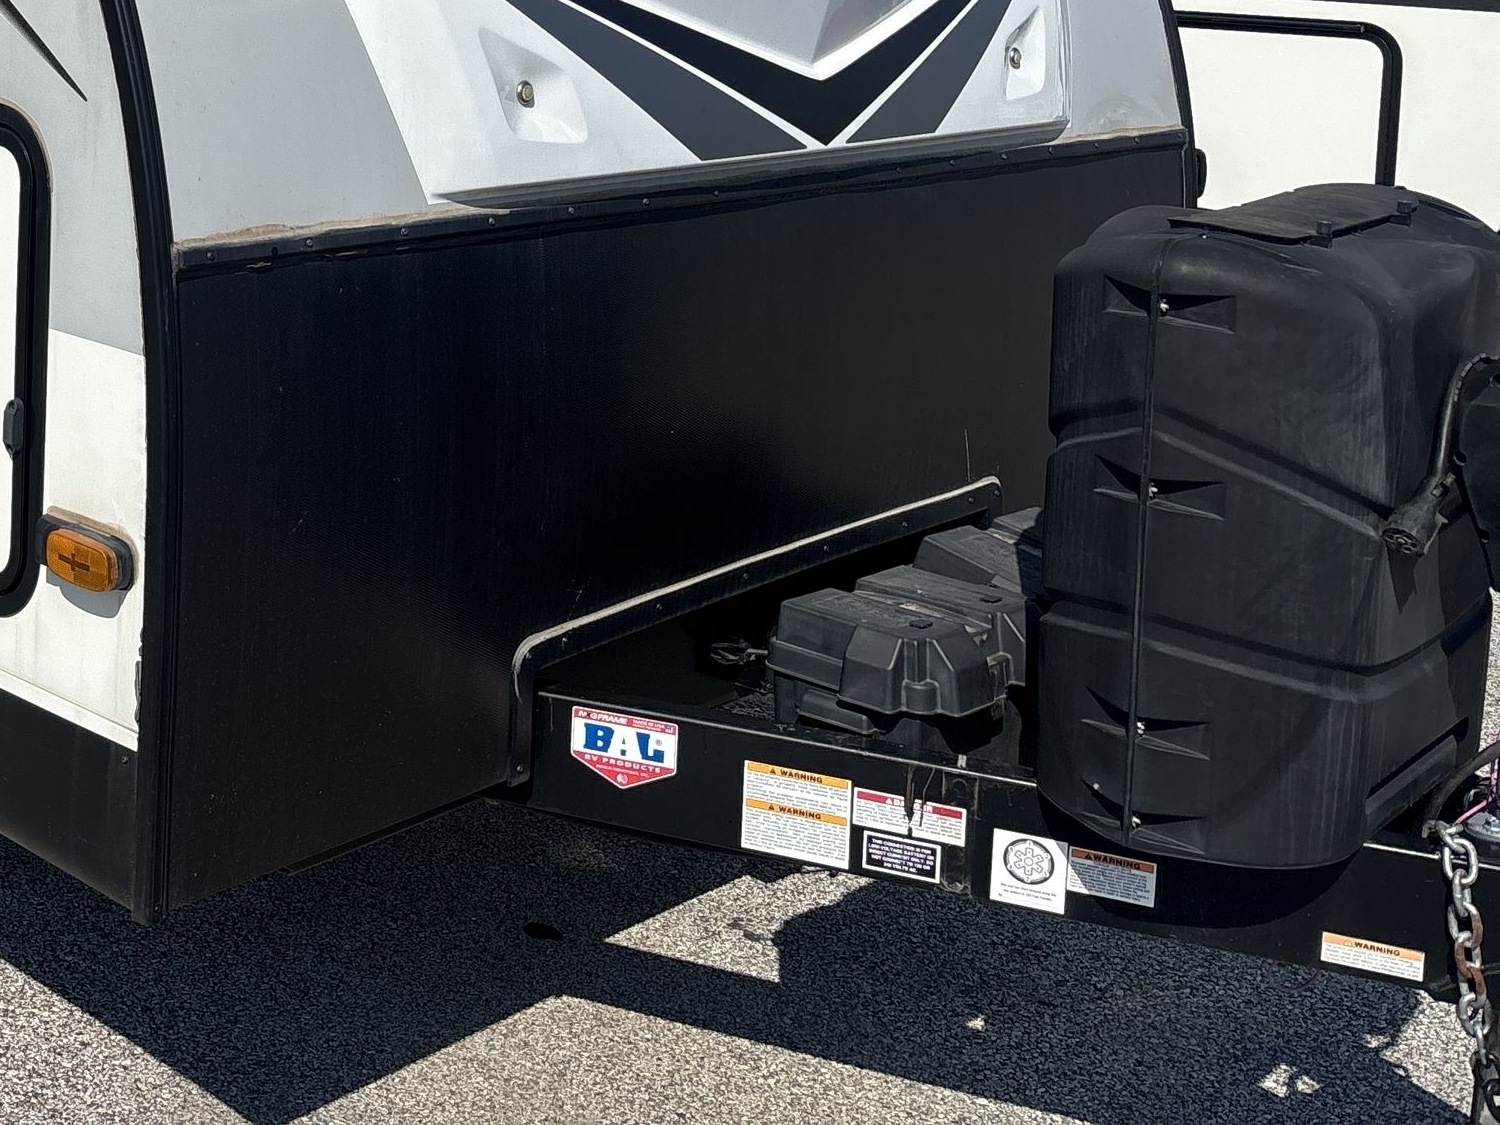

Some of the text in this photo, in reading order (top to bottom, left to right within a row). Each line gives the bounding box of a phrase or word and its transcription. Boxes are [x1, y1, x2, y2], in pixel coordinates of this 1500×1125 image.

[597, 713, 628, 725] FRAME
[583, 722, 665, 763] BAL
[584, 754, 661, 774] RV PRODUCTS
[780, 769, 823, 784] WARNING
[779, 805, 822, 820] WARNING
[893, 798, 933, 813] DAGER
[1093, 856, 1141, 870] WARNING
[1354, 941, 1401, 957] WARNING
